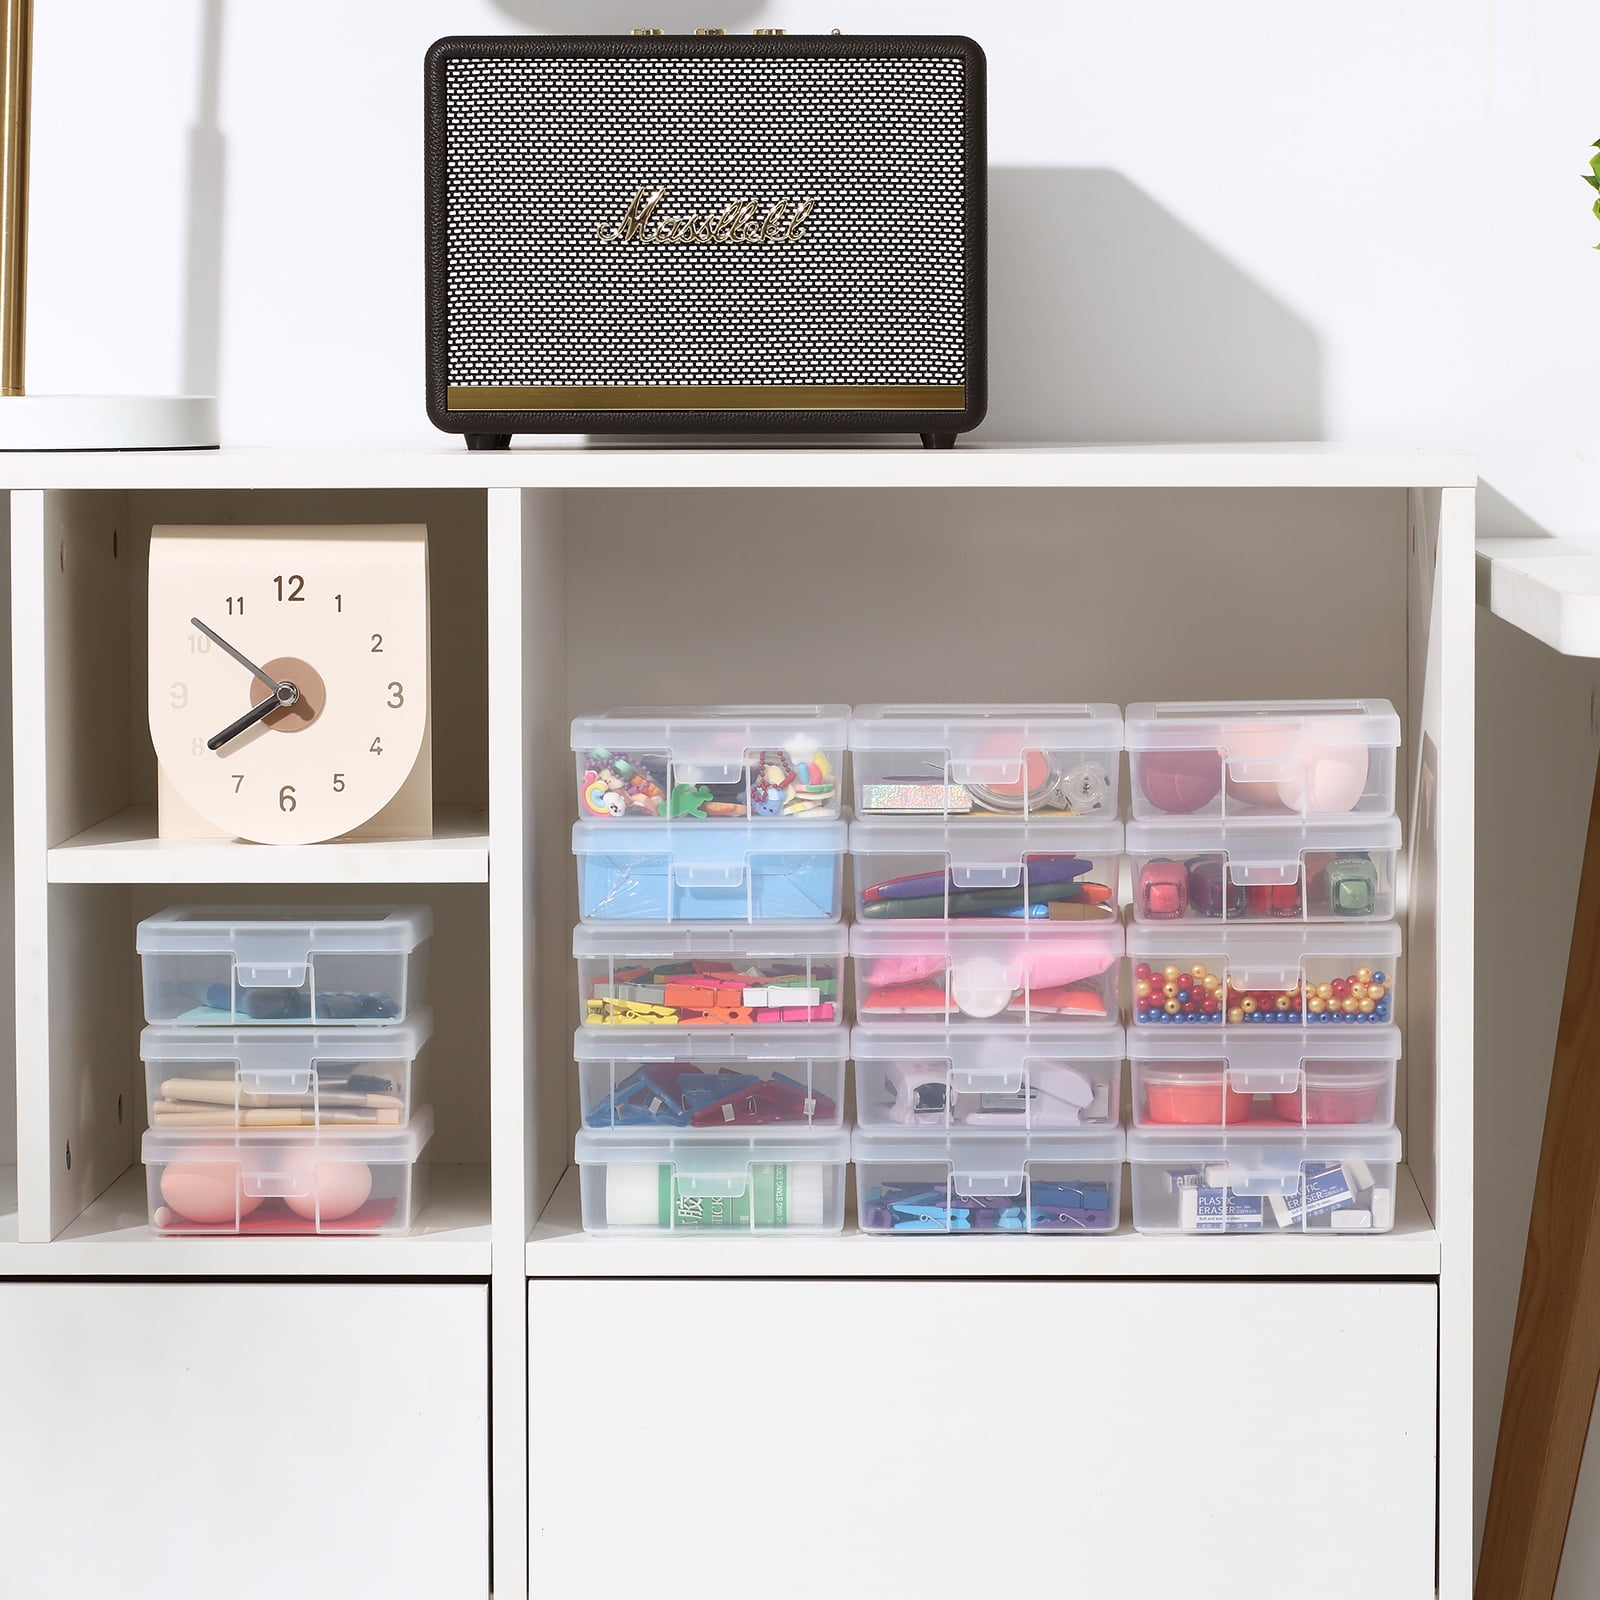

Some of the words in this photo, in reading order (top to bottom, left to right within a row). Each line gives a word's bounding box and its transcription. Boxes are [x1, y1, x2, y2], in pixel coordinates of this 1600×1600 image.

[273, 574, 305, 602] 12
[225, 596, 244, 615] 11
[334, 594, 342, 612] 1
[188, 633, 211, 654] 10
[371, 633, 384, 653] 2
[170, 682, 189, 709] 9
[386, 681, 405, 709] 3
[191, 737, 205, 756] 8
[369, 736, 384, 756] 4
[231, 774, 245, 793] 7
[332, 773, 346, 792] 5
[279, 785, 297, 812] 6
[711, 1197, 723, 1226] TICK
